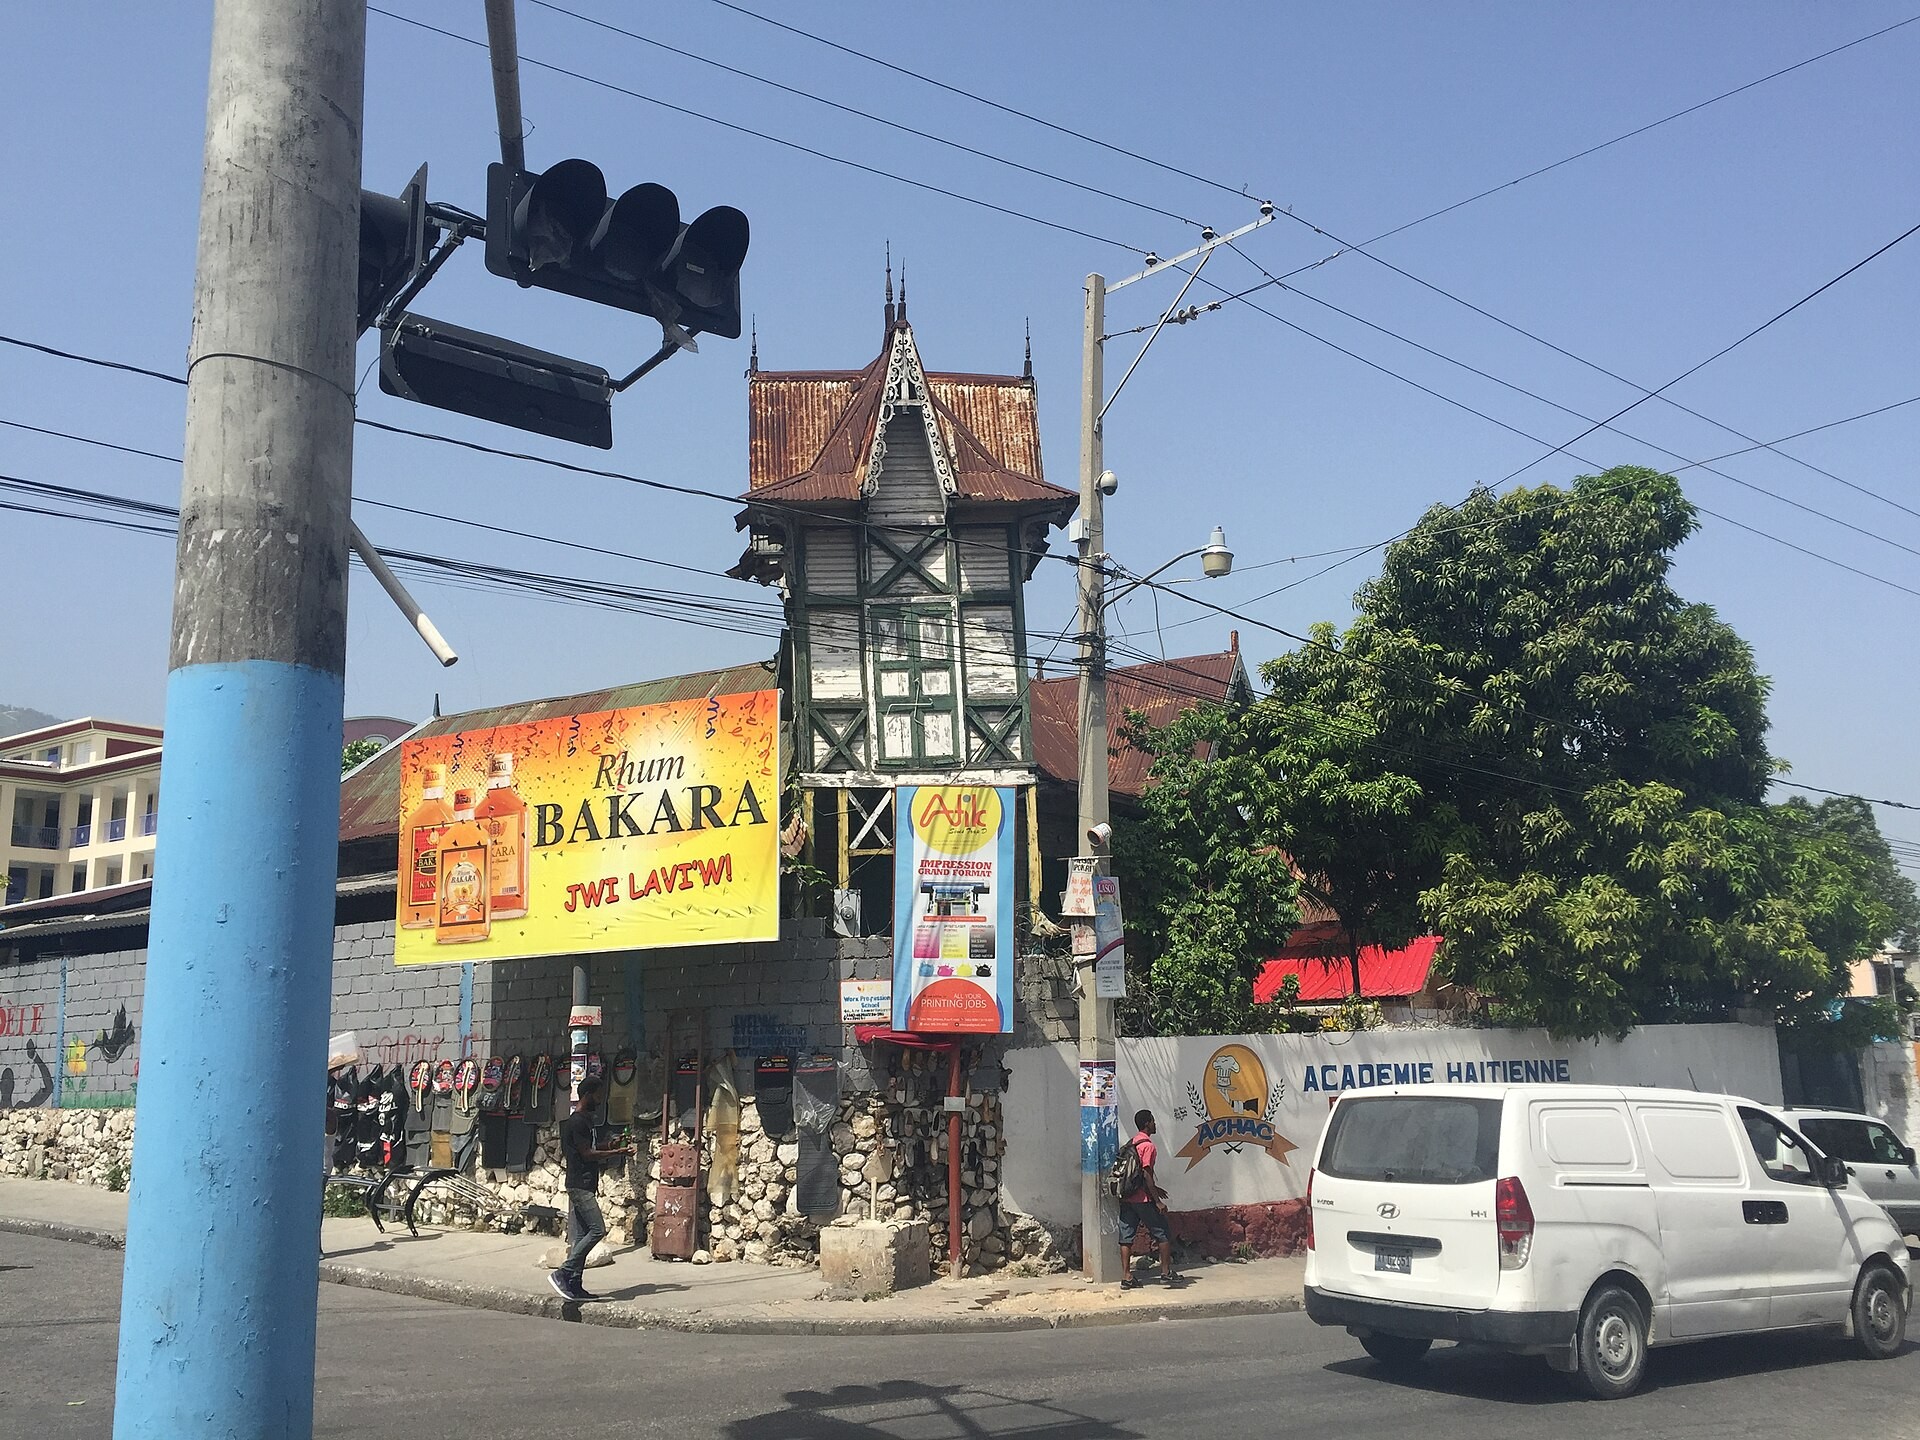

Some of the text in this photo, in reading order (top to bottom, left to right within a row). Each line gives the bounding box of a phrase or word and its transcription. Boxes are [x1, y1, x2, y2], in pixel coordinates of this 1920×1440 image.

[592, 751, 685, 789] Rhum
[533, 780, 768, 847] BAKARA
[919, 793, 987, 828] Atik
[418, 858, 436, 867] BAK
[918, 867, 993, 878] GRAND FORMAT
[919, 859, 993, 870] IMPRESSION
[564, 853, 733, 912] JWI LAVI'W!
[921, 999, 987, 1009] PRINTING JOBS
[1304, 1060, 1571, 1091] ACADEMIE HAITIENNE
[1198, 1119, 1274, 1145] ACHAC
